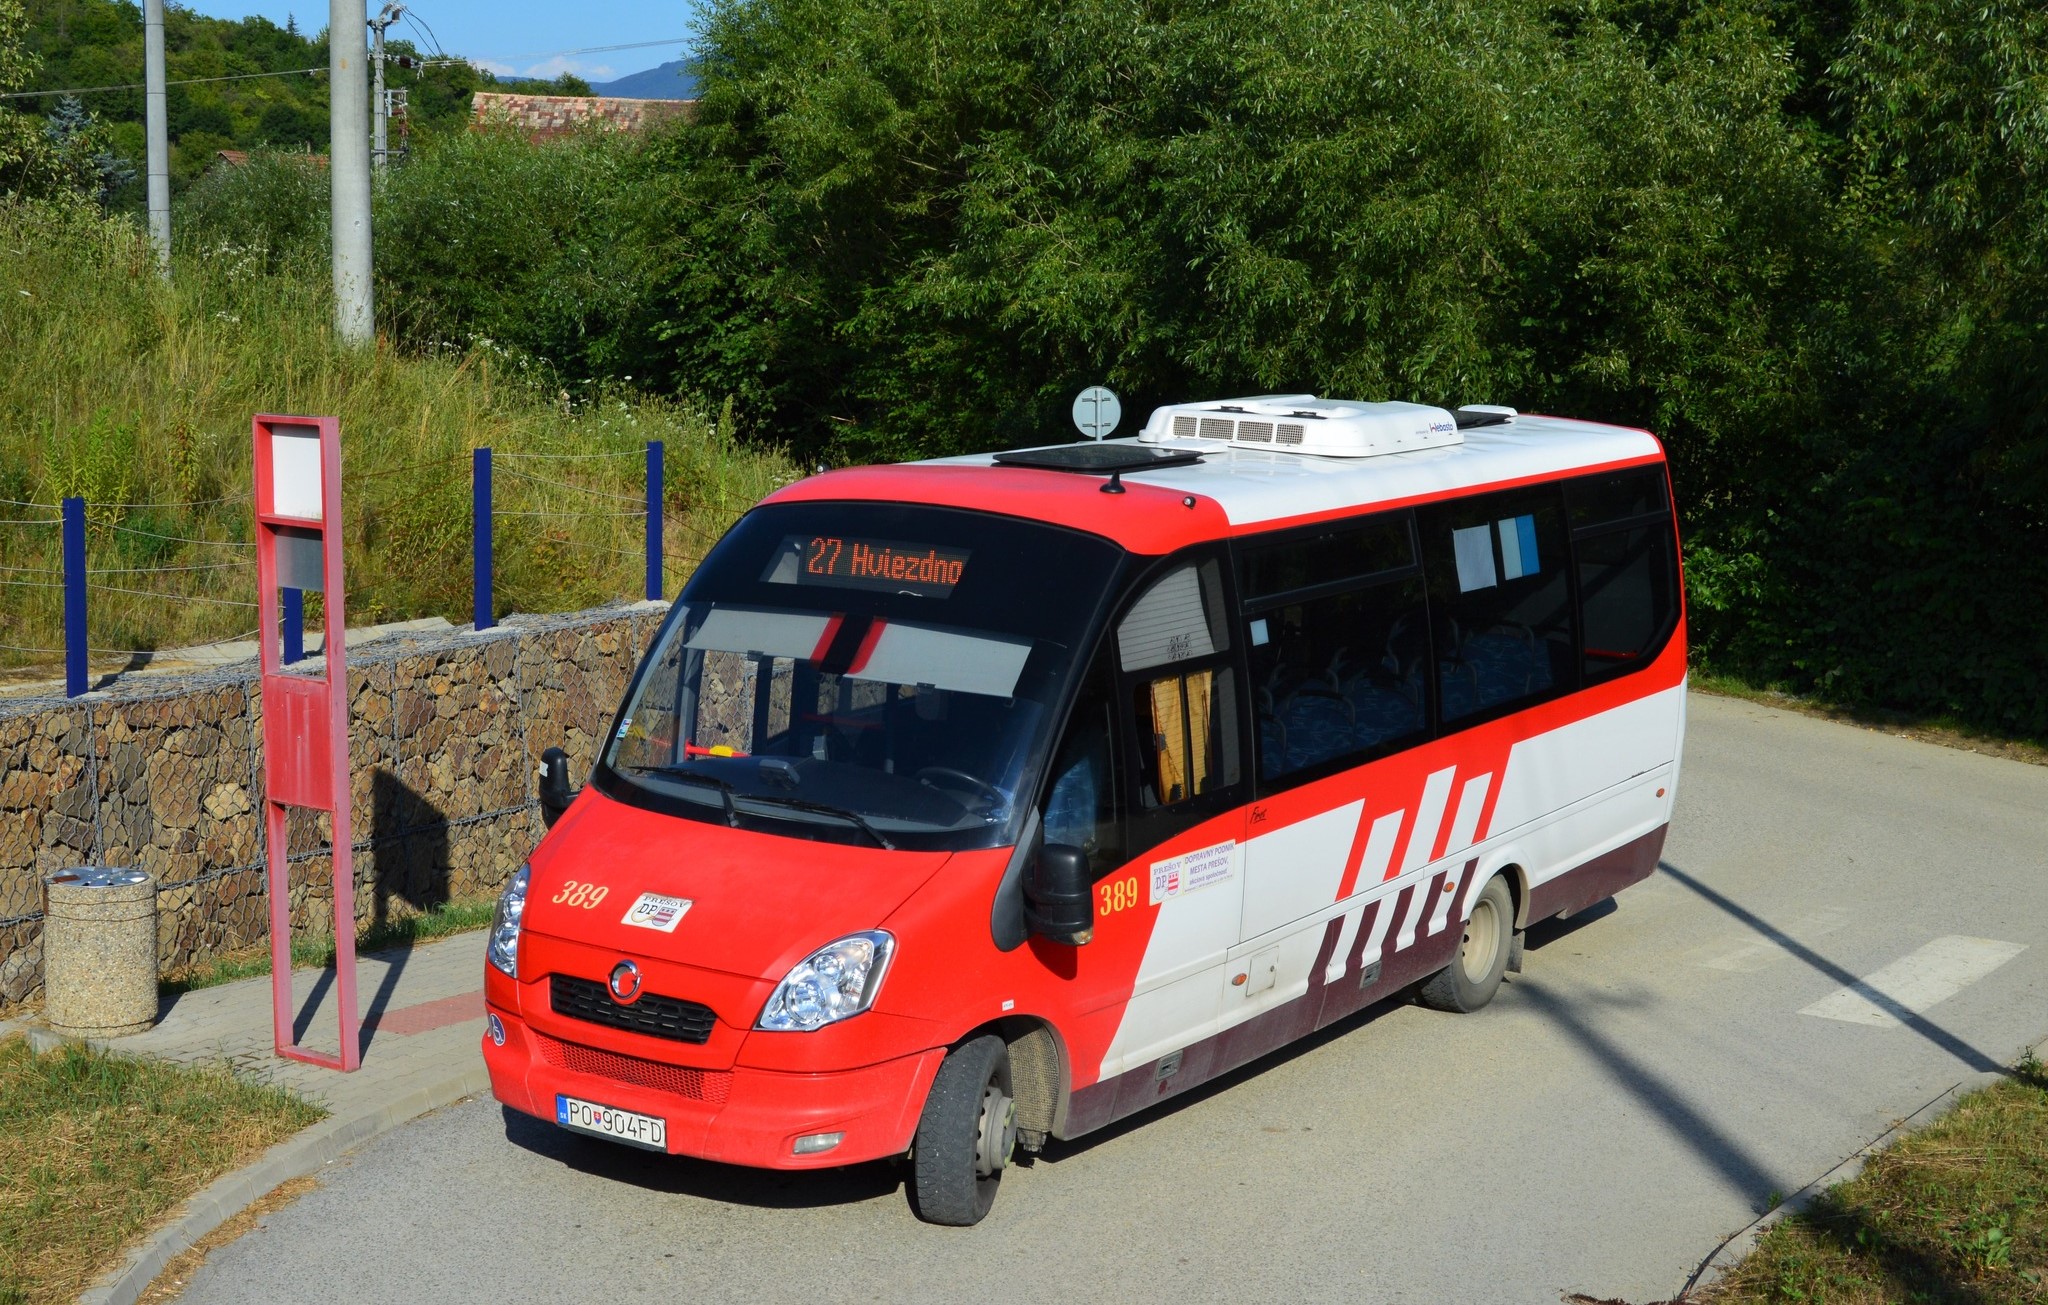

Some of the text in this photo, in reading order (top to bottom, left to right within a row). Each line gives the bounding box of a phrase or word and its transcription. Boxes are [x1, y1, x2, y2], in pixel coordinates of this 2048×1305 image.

[1429, 422, 1454, 432] Webasto
[808, 537, 963, 584] 27 Hviezdno
[1214, 842, 1235, 856] PODNIK
[1189, 863, 1208, 875] MESTA
[1155, 875, 1167, 889] DP
[552, 880, 609, 909] 389
[1100, 877, 1138, 916] 389
[637, 903, 658, 915] DP
